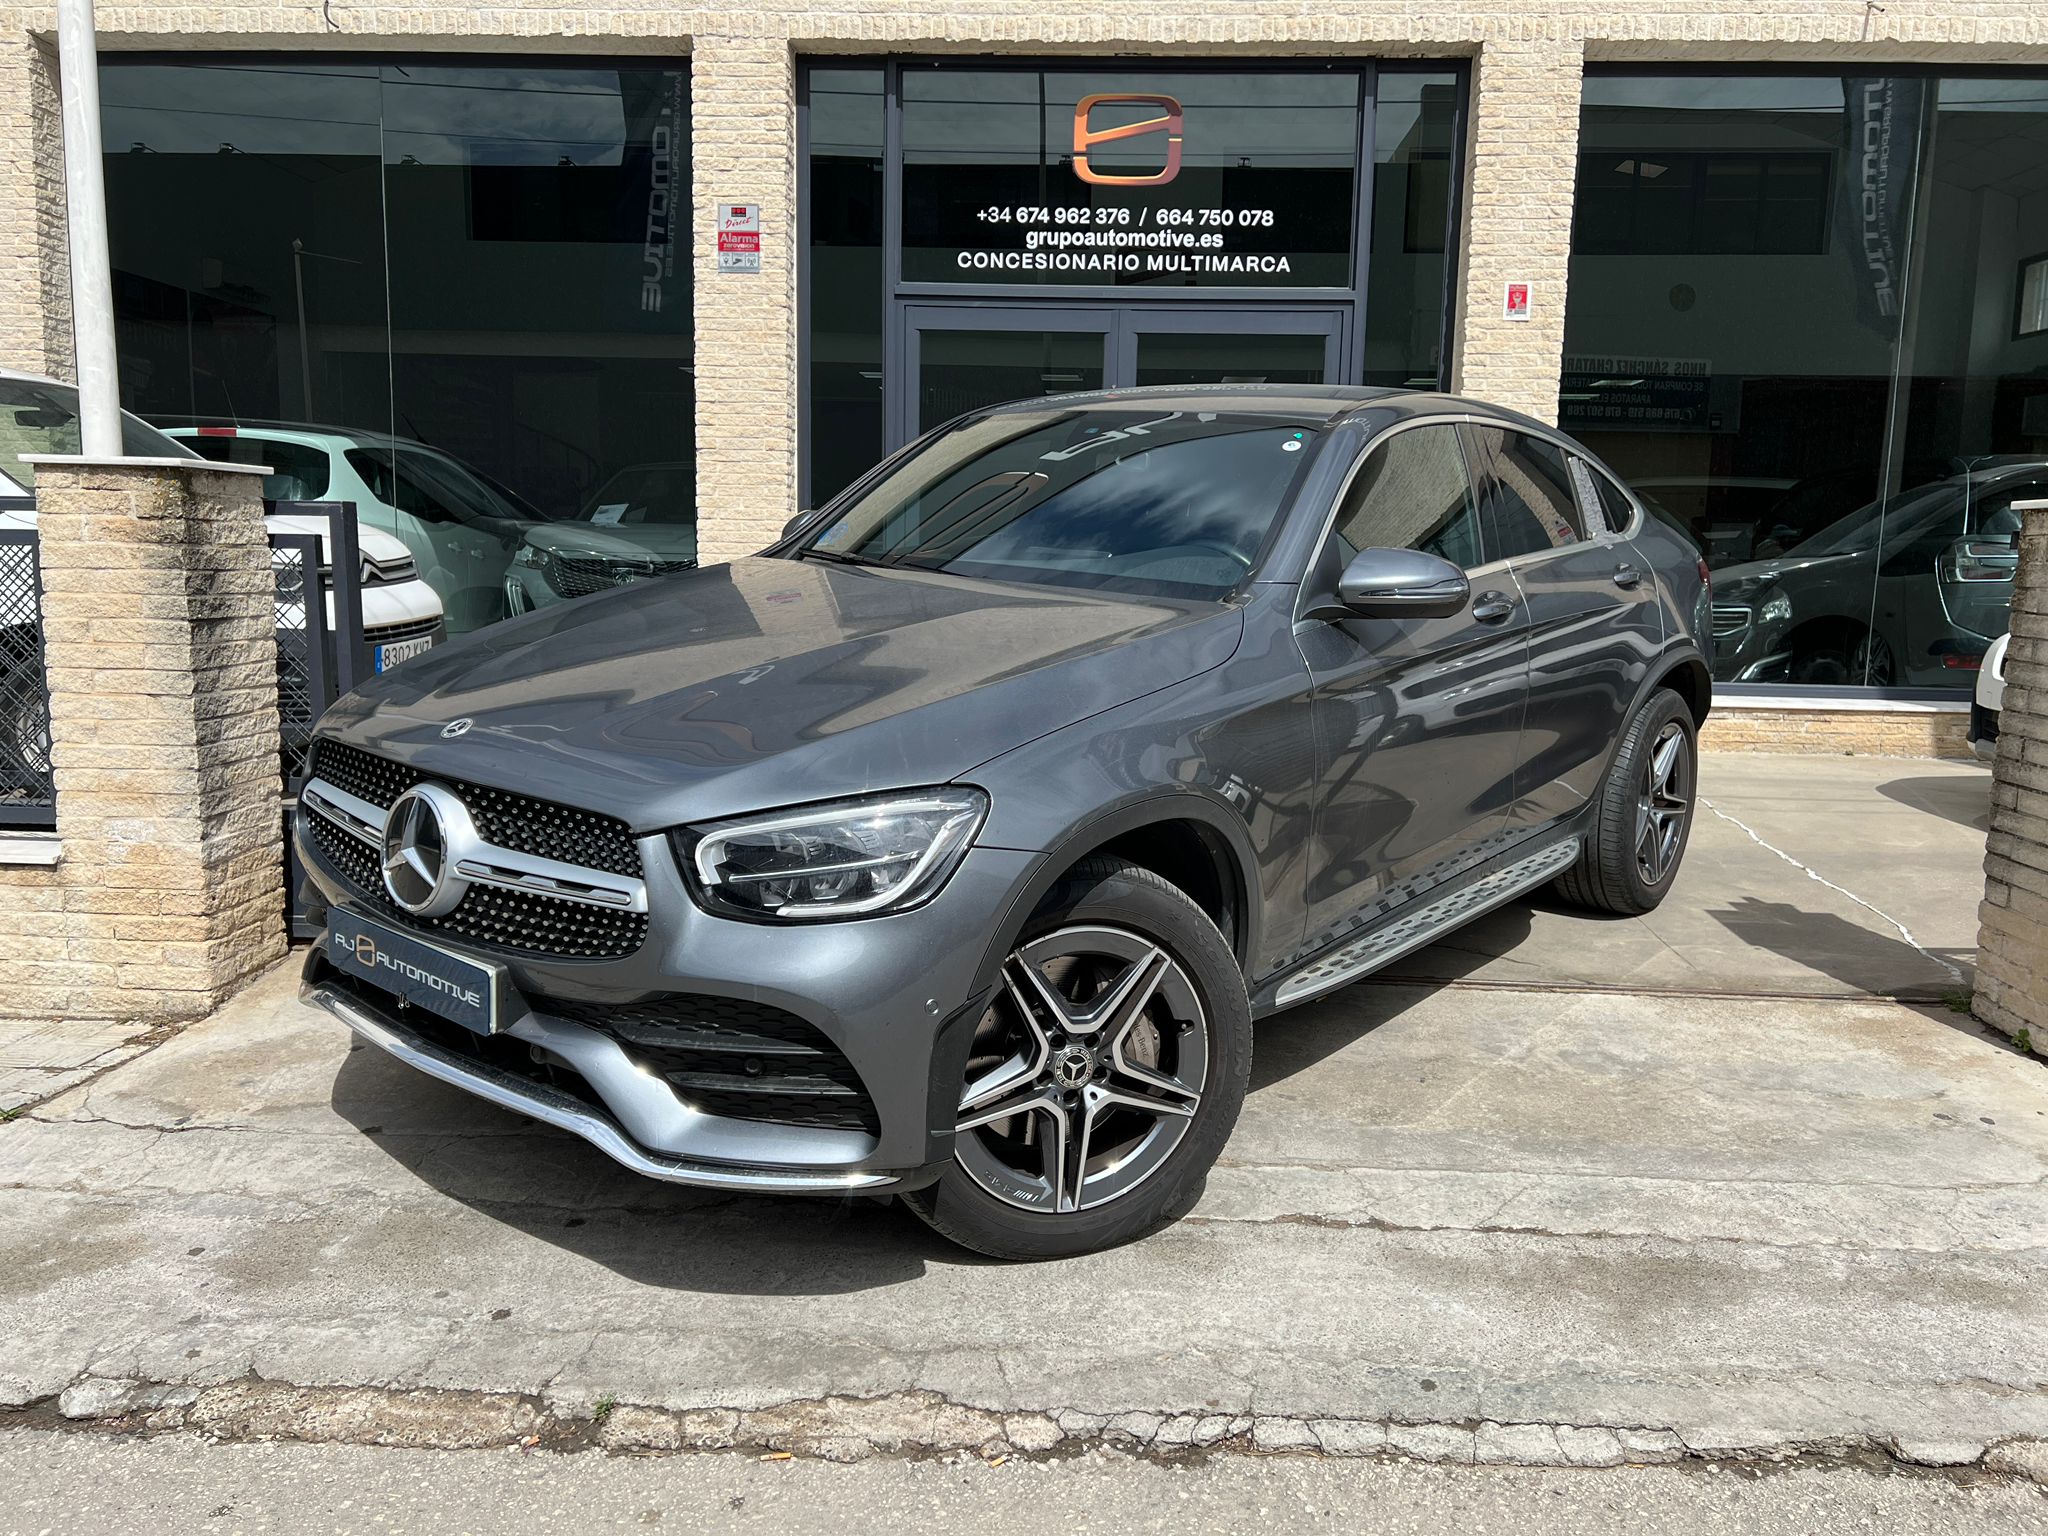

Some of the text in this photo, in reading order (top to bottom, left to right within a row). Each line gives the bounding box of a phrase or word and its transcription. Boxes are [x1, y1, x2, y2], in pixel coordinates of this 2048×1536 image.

[976, 207, 1274, 227] +34 674 962 376 / 664 750 078
[720, 232, 758, 243] Alarma
[1026, 228, 1224, 250] grupoautomotive.es
[957, 251, 1291, 273] CONCESIONARIO MULTIMARCA
[384, 645, 411, 667] 8302
[335, 932, 355, 952] AJ
[376, 951, 480, 1008] AUTOMOTIVE
